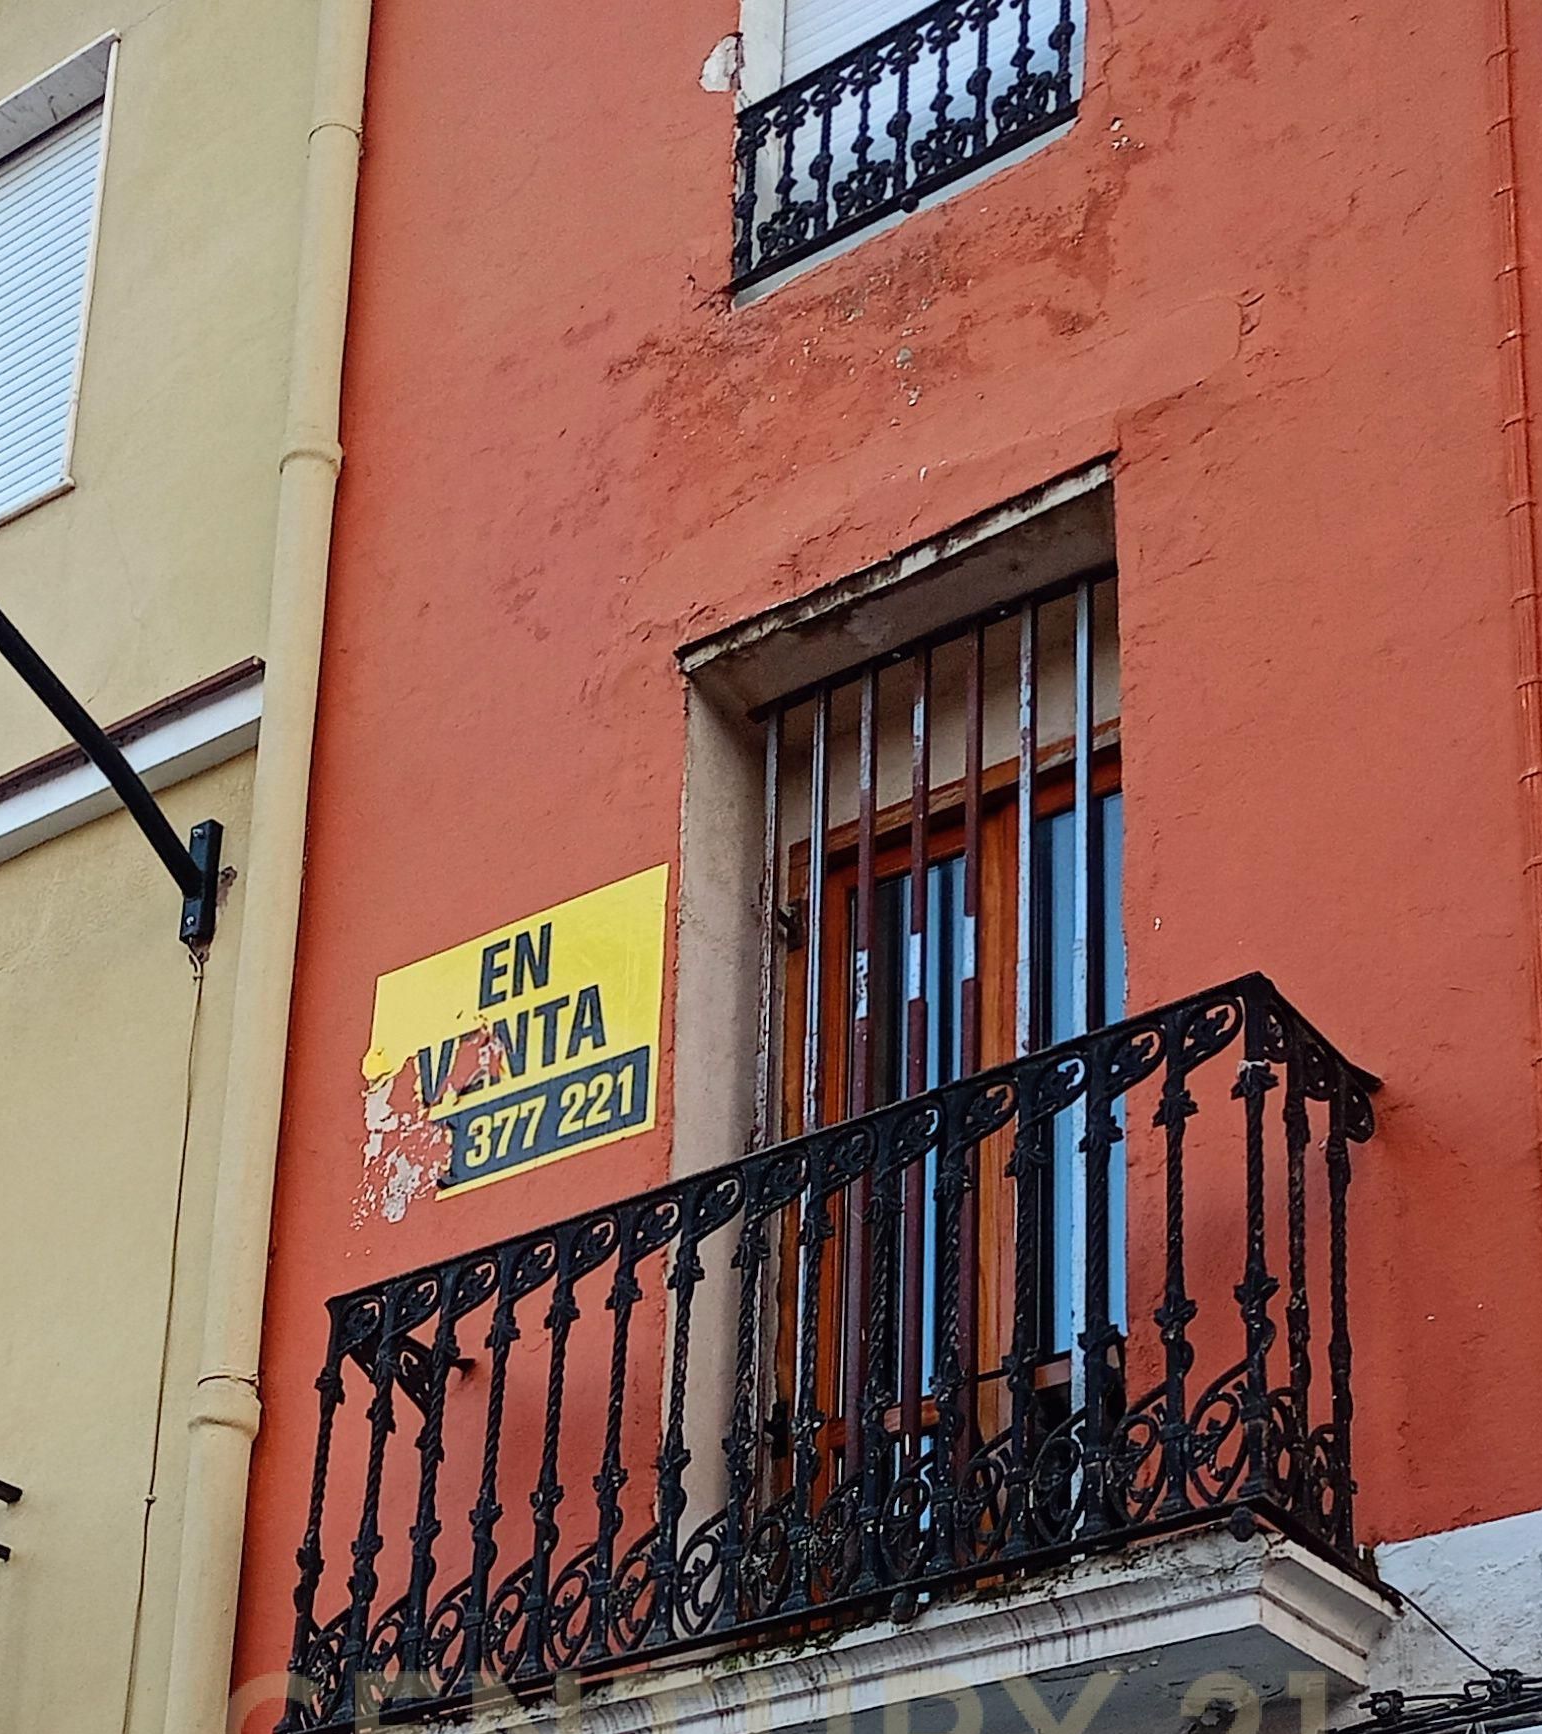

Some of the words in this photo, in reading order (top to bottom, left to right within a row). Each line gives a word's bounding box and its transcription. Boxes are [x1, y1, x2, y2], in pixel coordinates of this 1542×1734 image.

[477, 922, 553, 1011] EN
[464, 1095, 548, 1170] 377
[557, 1064, 635, 1138] 221
